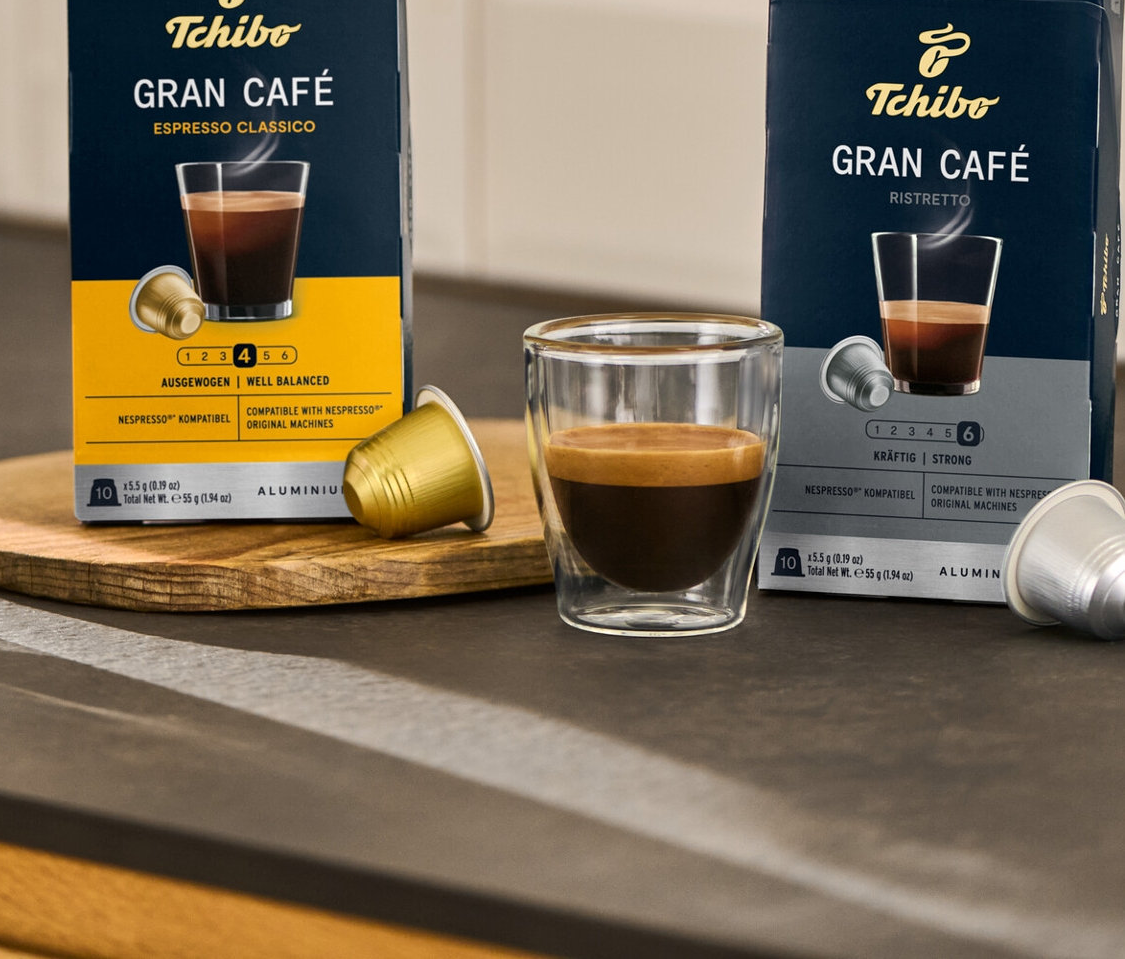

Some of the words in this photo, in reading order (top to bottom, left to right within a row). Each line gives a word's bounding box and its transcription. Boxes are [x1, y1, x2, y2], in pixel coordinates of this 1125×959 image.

[165, 15, 301, 48] Tchibo
[134, 78, 225, 108] GRAN
[243, 69, 333, 107] CAFÉ
[866, 83, 1000, 119] Tchibo
[154, 122, 232, 134] ESPRESSO
[237, 120, 315, 133] CLASSICO
[832, 145, 922, 178] GRAN
[940, 144, 1029, 182] CAFÉ
[890, 192, 970, 206] RISTRETTO
[186, 352, 190, 361] 1
[201, 352, 208, 361] 2
[220, 352, 226, 361] 3
[238, 348, 251, 363] 4
[263, 351, 270, 360] 5
[281, 351, 288, 360] 6
[161, 377, 230, 388] AUSGEWOGEN
[247, 376, 272, 386] WELL
[276, 376, 329, 386] BALANCED
[247, 407, 298, 416] COMPATIBLE
[301, 406, 323, 416] WITH
[179, 414, 230, 424] KOMPATIBEL
[247, 420, 287, 429] ORIGINAL
[290, 419, 333, 428] MACHINES
[875, 426, 879, 434] 1
[890, 426, 897, 435] 2
[909, 427, 915, 436] 3
[926, 428, 933, 437] 4
[945, 429, 952, 438] 5
[963, 426, 974, 441] 6
[874, 450, 916, 462] KRÄFTIG
[932, 454, 972, 465] STRONG
[96, 487, 112, 500] 10
[143, 484, 146, 492] g
[149, 481, 166, 491] (0.19
[169, 481, 180, 491] oz)
[864, 488, 915, 499] KOMPATIBEL
[932, 485, 982, 496] COMPATIBLE
[986, 488, 1006, 498] WITH
[124, 494, 141, 504] Total
[144, 495, 156, 504] Net
[158, 495, 169, 504] Wt.
[194, 496, 198, 505] g
[201, 493, 218, 504] (1.94
[220, 493, 231, 503] oz)
[932, 498, 970, 509] ORIGINAL
[974, 500, 1017, 512] MACHINES
[781, 556, 796, 570] 10
[827, 555, 830, 564] g
[833, 554, 850, 564] (0.19
[852, 555, 863, 565] oz)
[808, 565, 824, 576] Total
[827, 566, 839, 577] Net
[841, 568, 852, 578] Wt.
[876, 572, 880, 581] g
[883, 570, 900, 581] (1.94
[902, 571, 913, 582] oz)
[940, 566, 1000, 578] ALUMIN
